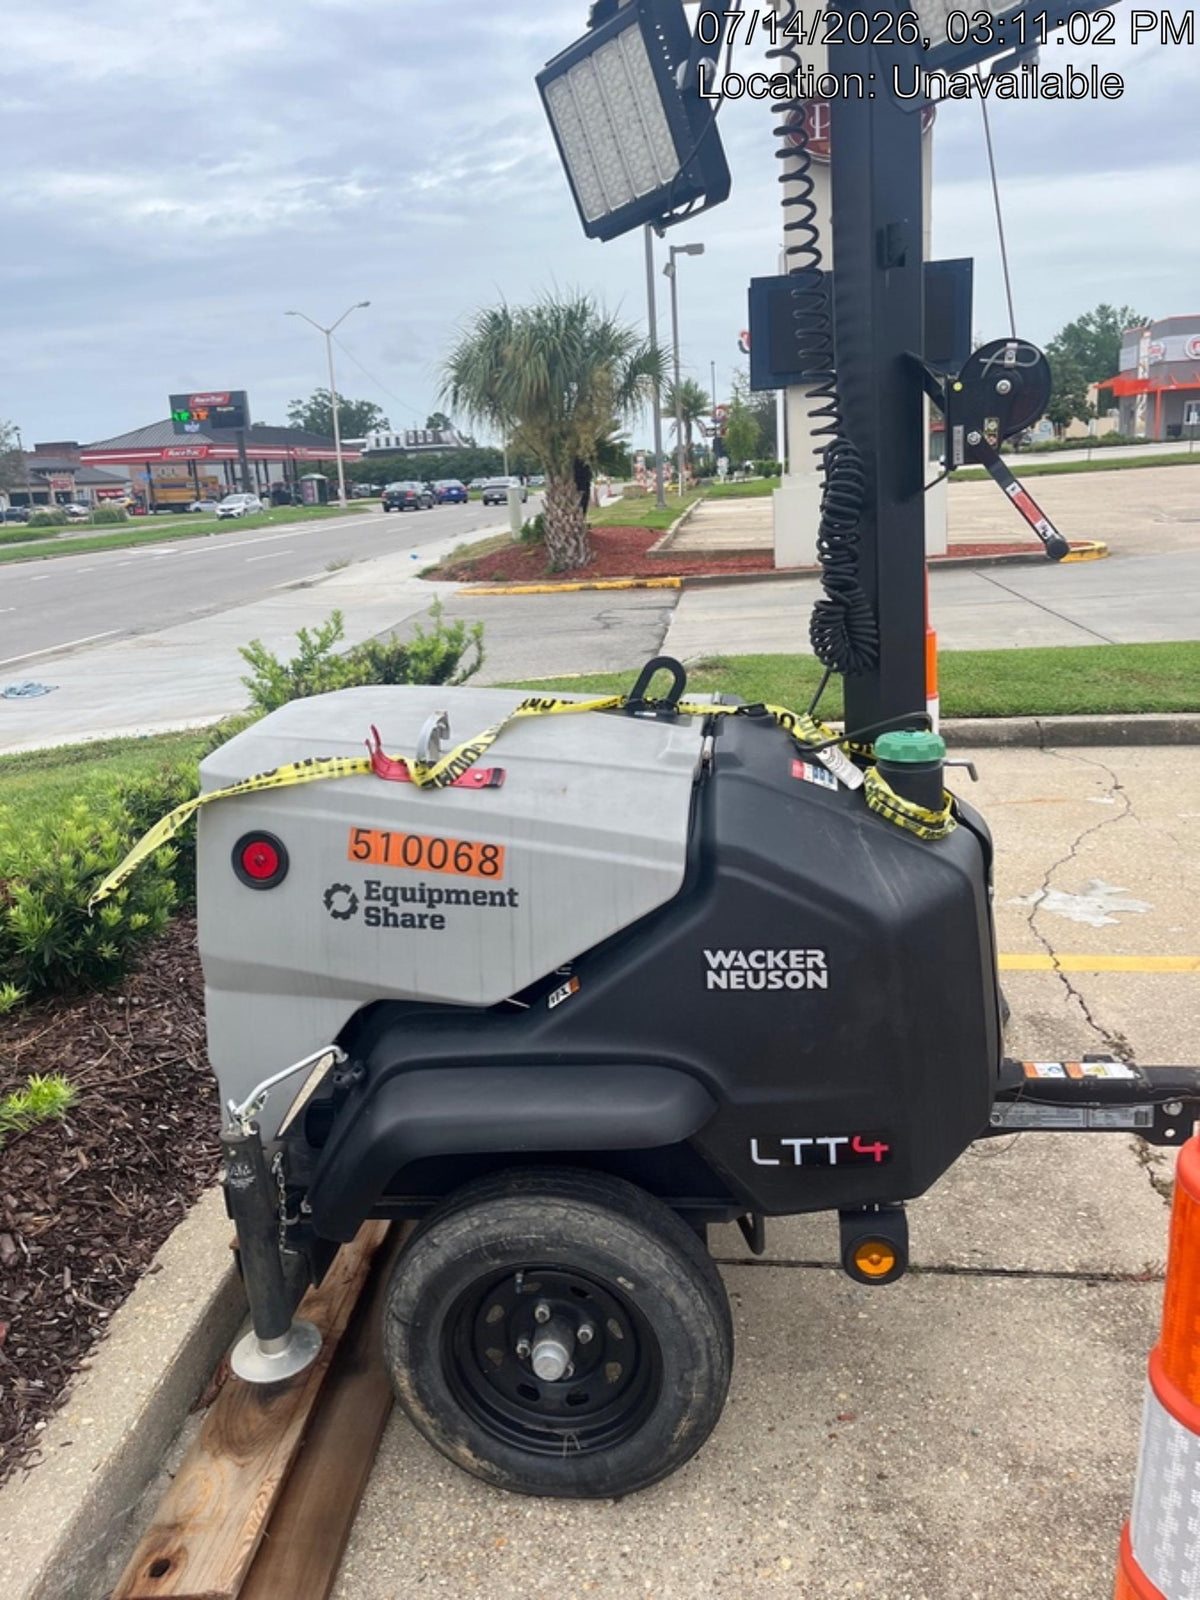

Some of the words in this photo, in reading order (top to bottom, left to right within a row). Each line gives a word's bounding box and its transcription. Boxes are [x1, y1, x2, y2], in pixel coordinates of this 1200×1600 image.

[352, 828, 499, 876] 510068
[364, 880, 519, 909] Equipment
[364, 906, 446, 930] Share
[703, 949, 828, 969] WACKER
[707, 970, 828, 989] NEUSON
[750, 1136, 889, 1165] LTT4
